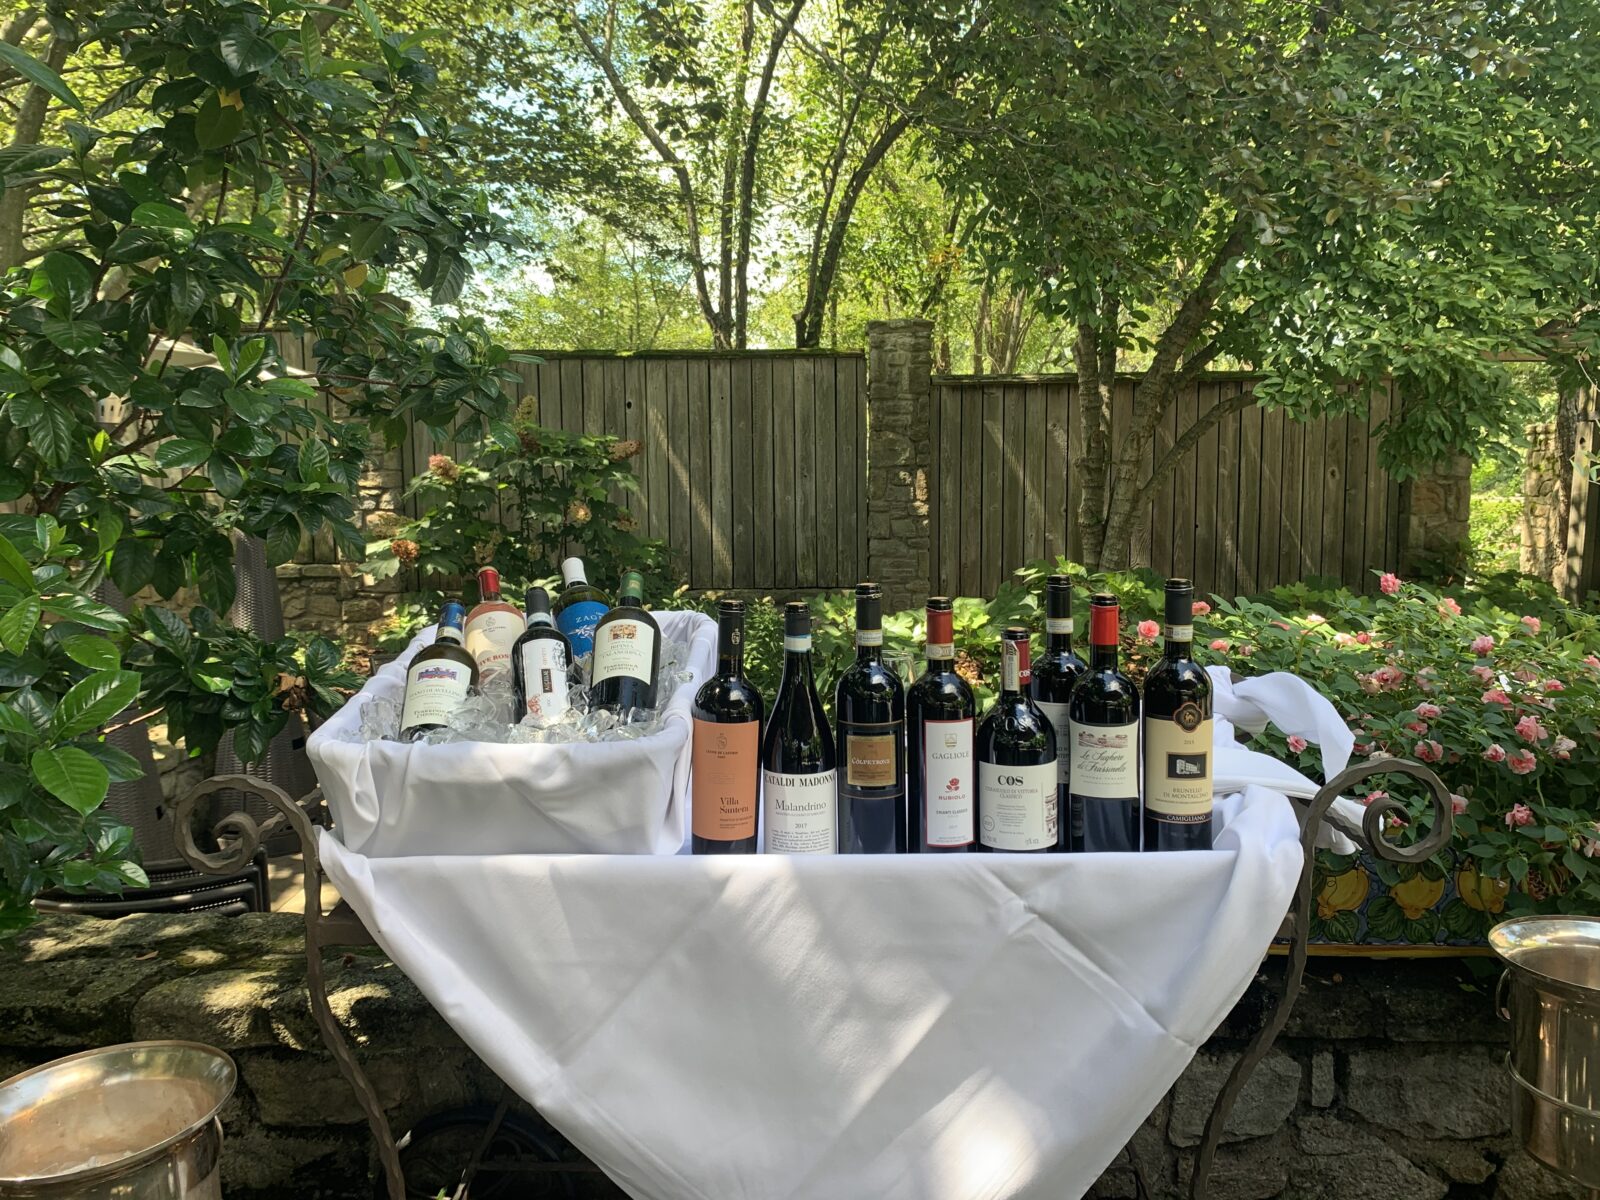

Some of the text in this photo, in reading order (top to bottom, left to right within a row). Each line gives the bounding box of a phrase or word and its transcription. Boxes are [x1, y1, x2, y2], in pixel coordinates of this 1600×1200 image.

[932, 751, 969, 760] GAGLIOLE
[764, 774, 795, 787] CATALDI
[998, 774, 1024, 787] COS
[720, 797, 739, 805] Villa
[775, 799, 827, 811] Malandrino
[1166, 814, 1206, 822] CAMIGLIANO
